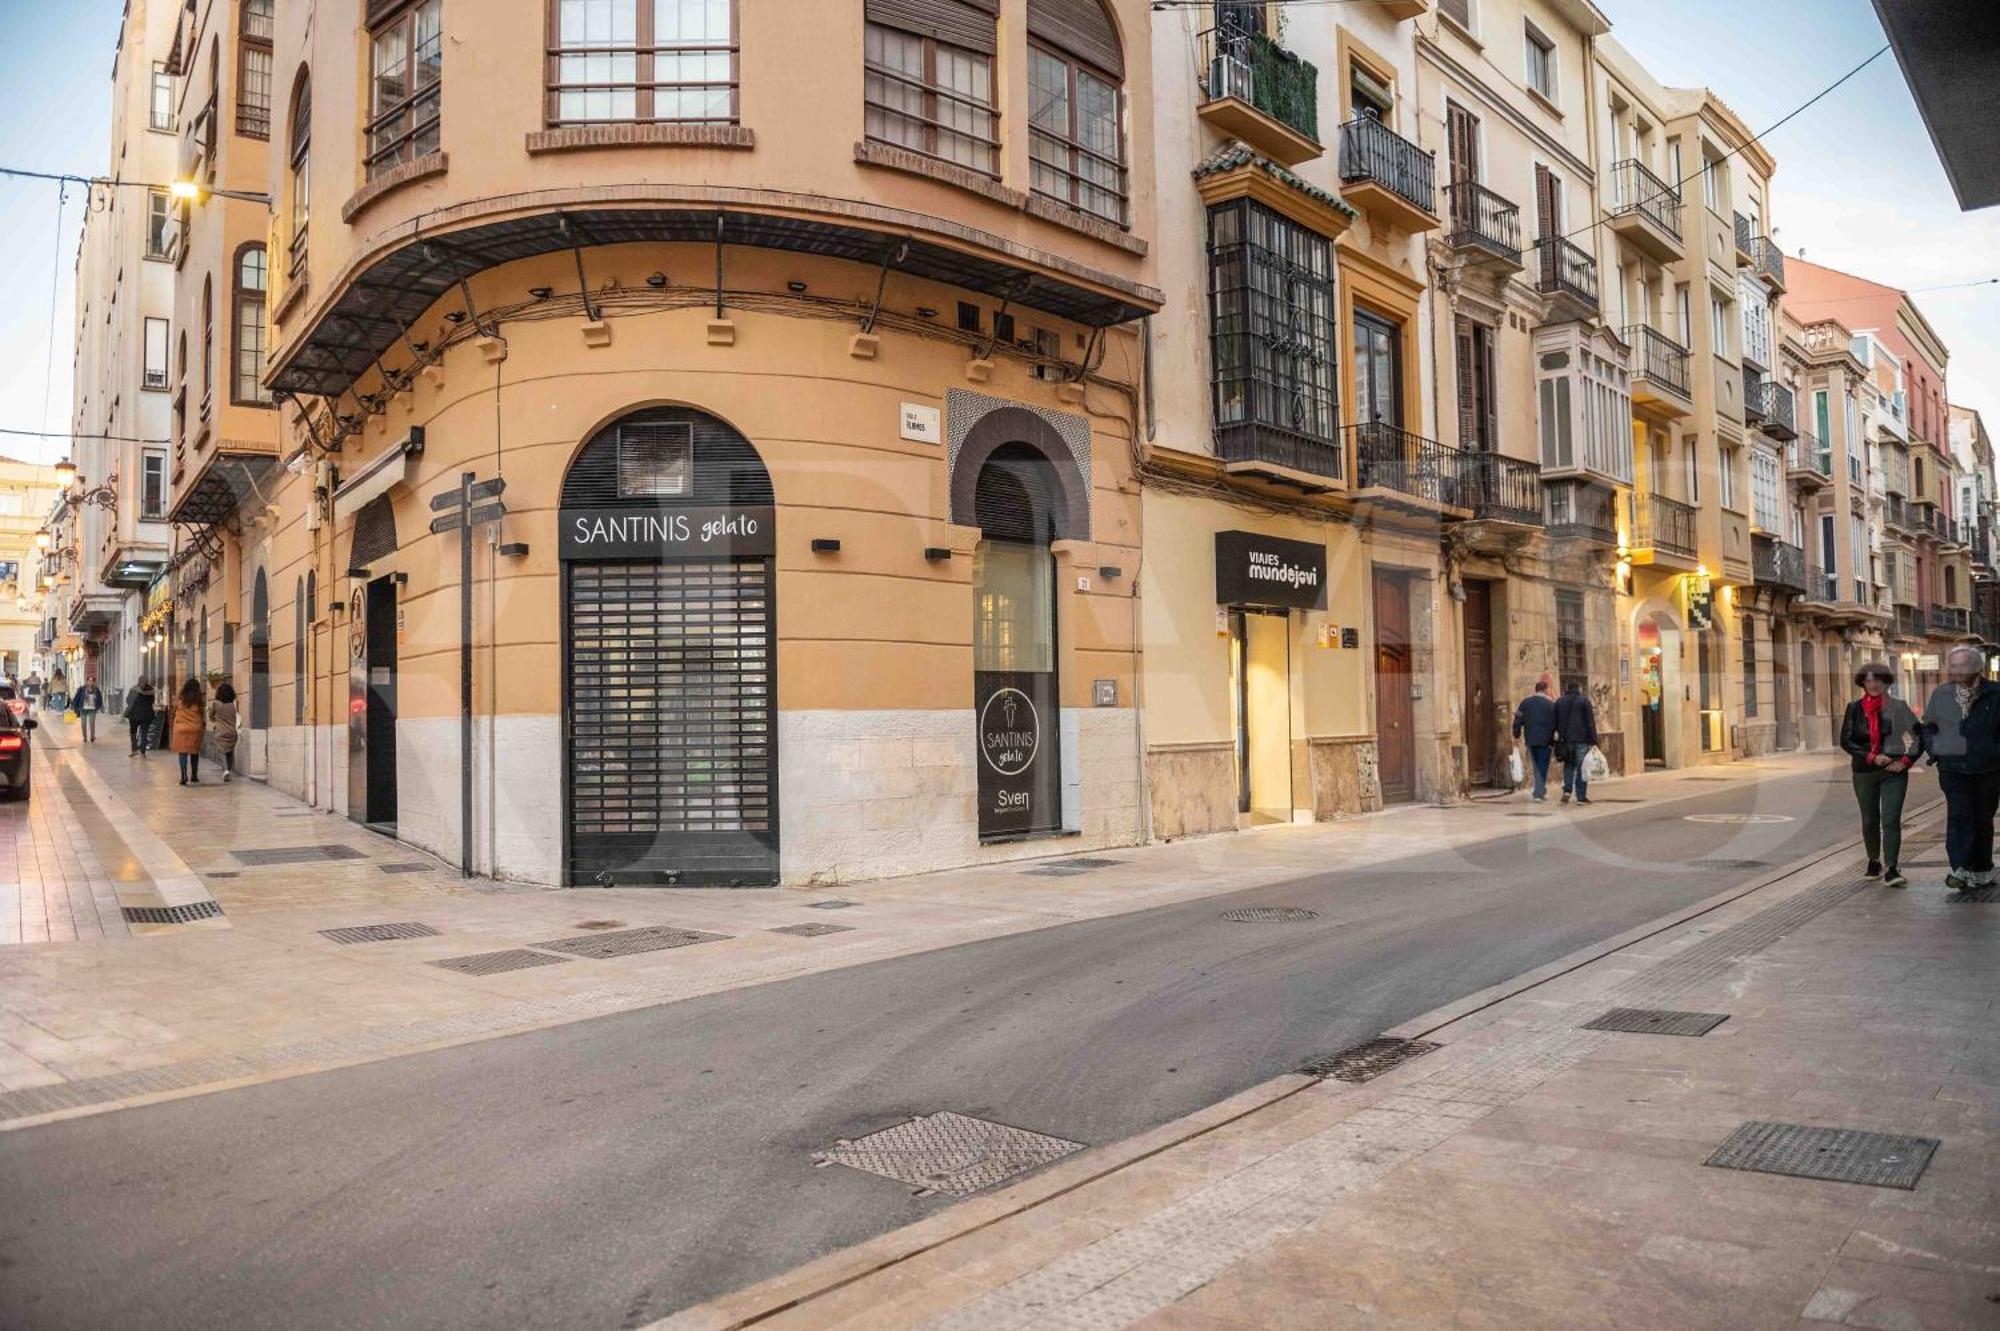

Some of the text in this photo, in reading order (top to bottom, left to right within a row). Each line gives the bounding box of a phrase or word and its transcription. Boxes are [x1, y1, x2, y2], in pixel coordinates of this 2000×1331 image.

[574, 514, 758, 543] SANTINIS gelato
[1249, 551, 1279, 566] VIAJES
[1249, 563, 1317, 589] mundejovi
[988, 732, 1034, 748] SANTINIS
[999, 749, 1024, 767] gelato
